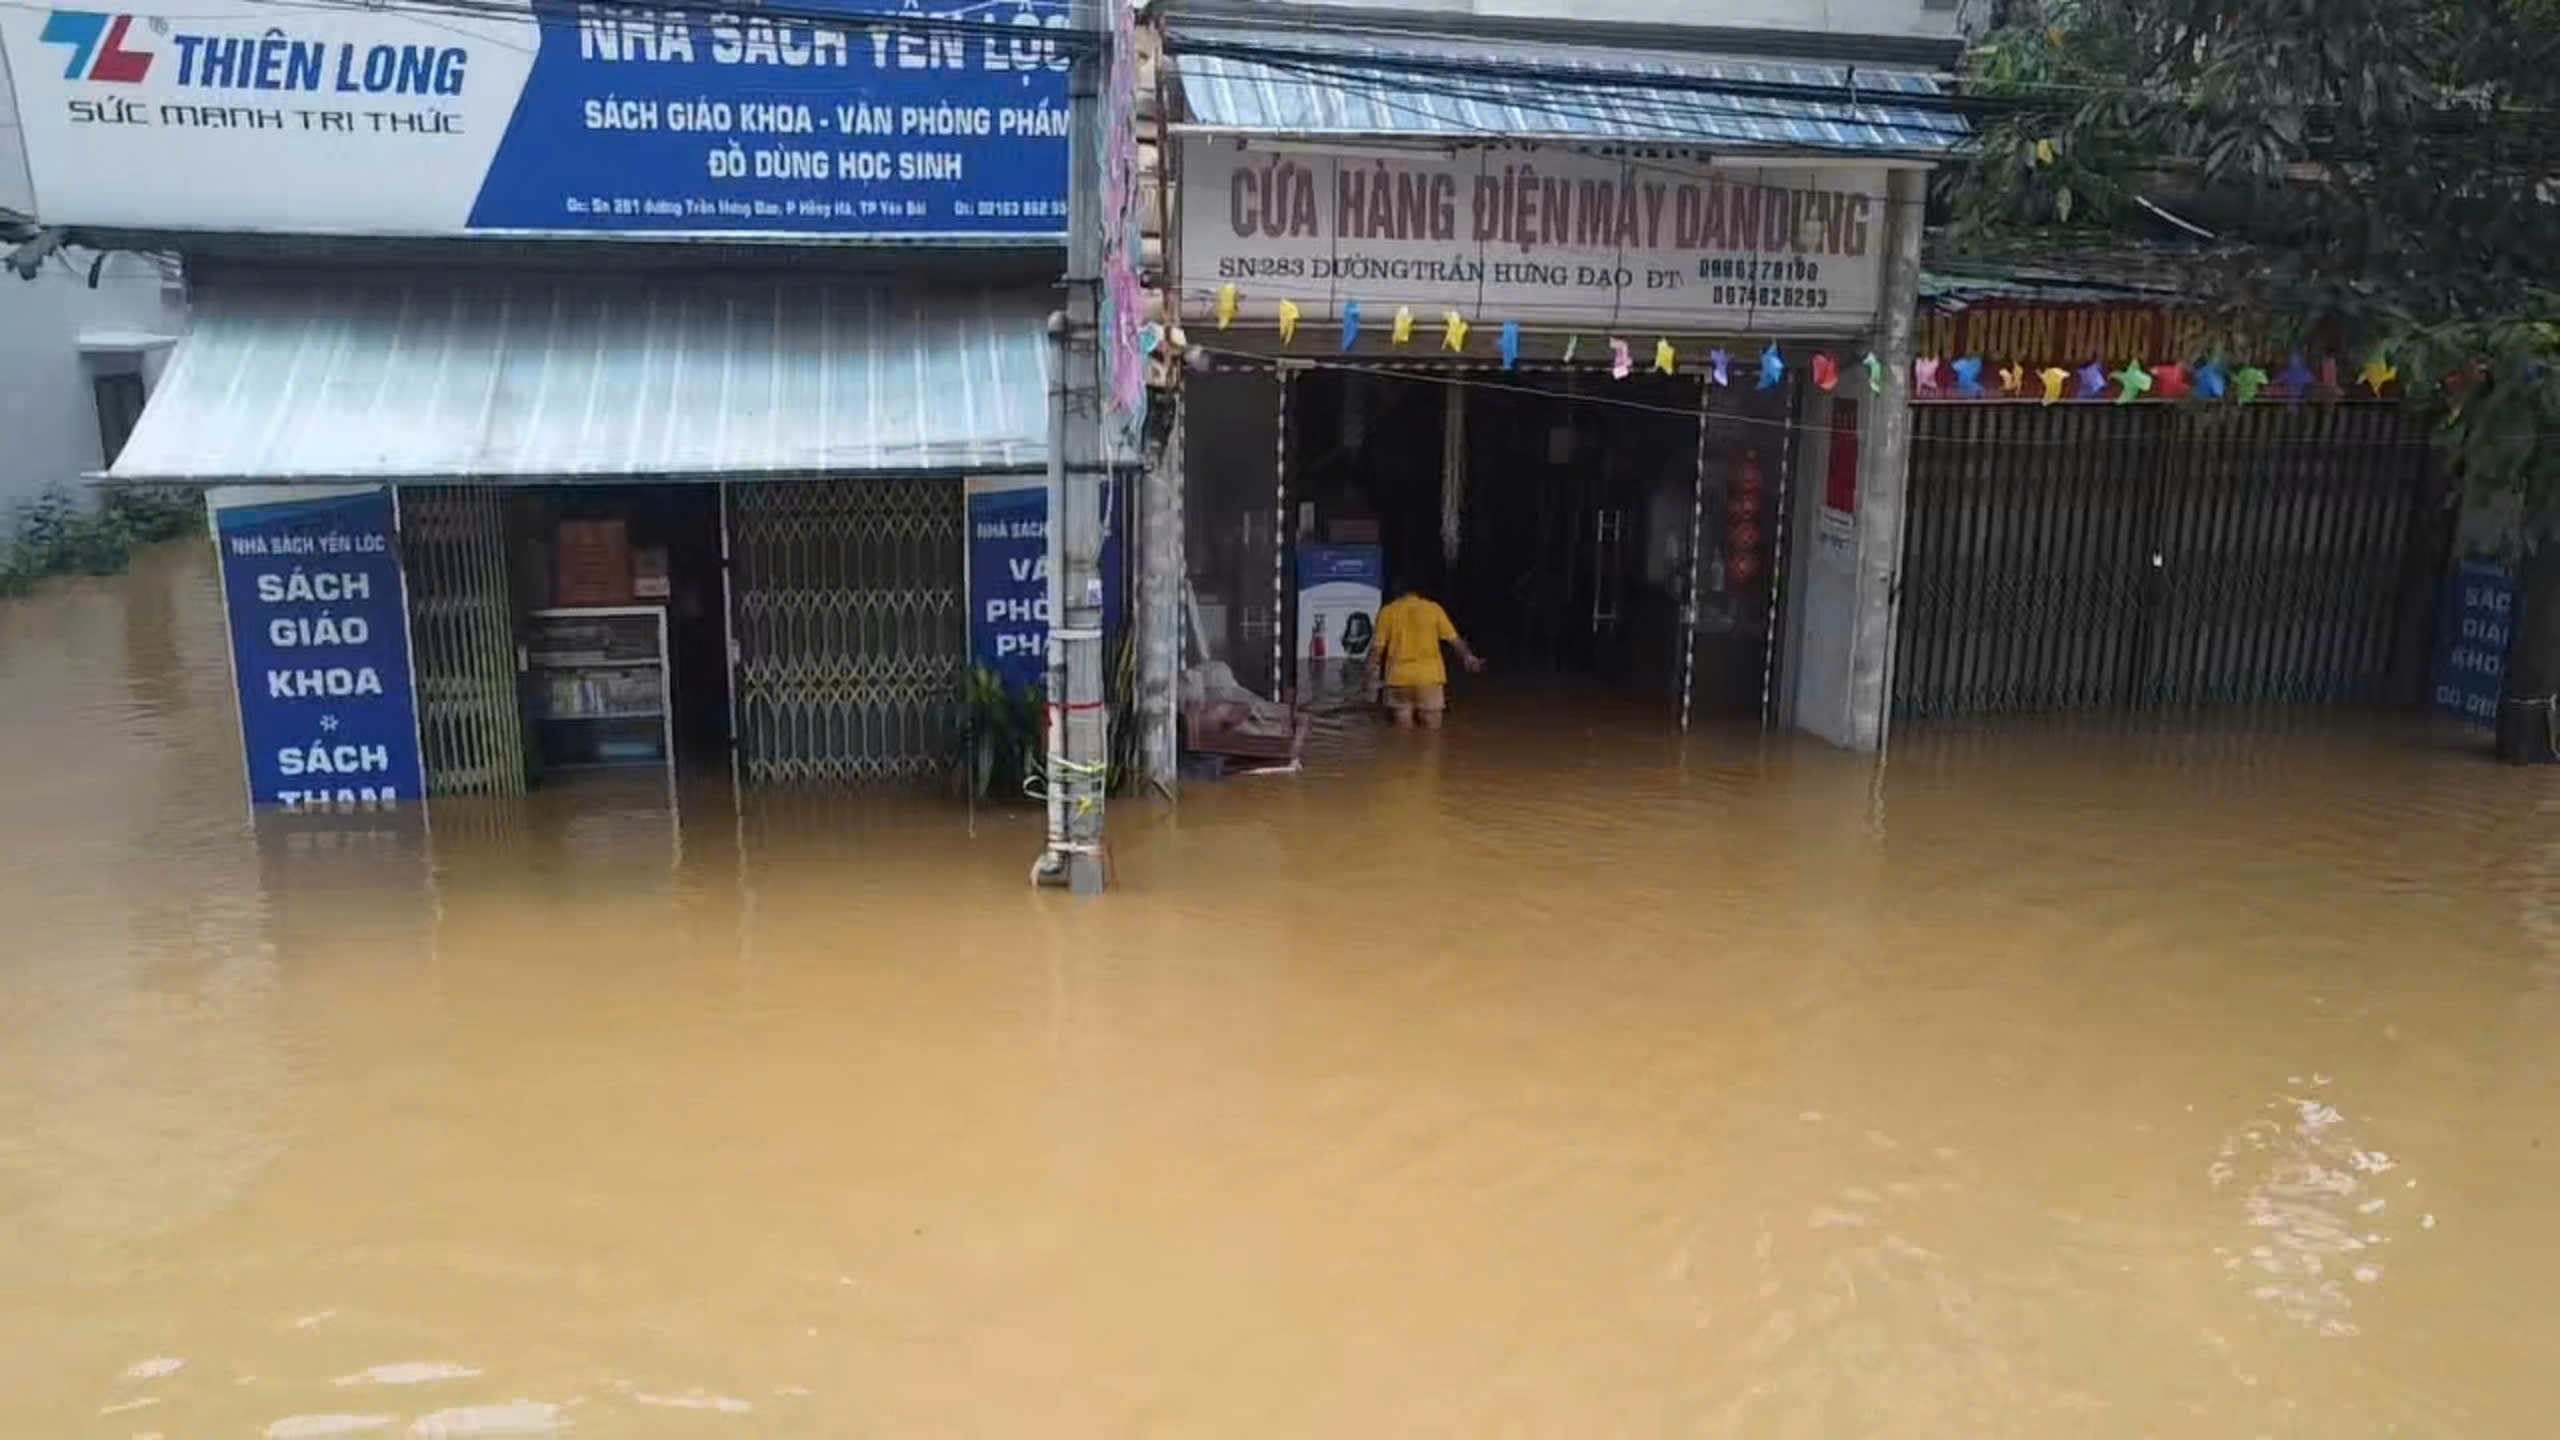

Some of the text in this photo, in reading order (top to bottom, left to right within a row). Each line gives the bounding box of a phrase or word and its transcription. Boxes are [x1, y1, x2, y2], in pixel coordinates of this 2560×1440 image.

[173, 27, 468, 96] THIÊN LONG
[68, 95, 149, 125] SỨC
[160, 103, 284, 130] MẠNH
[293, 110, 355, 132] TRI
[584, 92, 659, 130] SÁCH
[667, 94, 732, 131] GIÁO
[740, 102, 813, 133] KHOA
[902, 98, 991, 136] PHÒNG
[755, 141, 829, 179] DÙNG
[838, 151, 892, 187] HỌC
[899, 152, 963, 180] SINH
[1338, 158, 1456, 241] HÀNG
[257, 566, 370, 602] SÁCH
[986, 592, 1050, 623] PHÒ
[269, 609, 369, 647] GIÁO
[267, 666, 383, 698] KHOA
[277, 739, 389, 776] SÁCH
